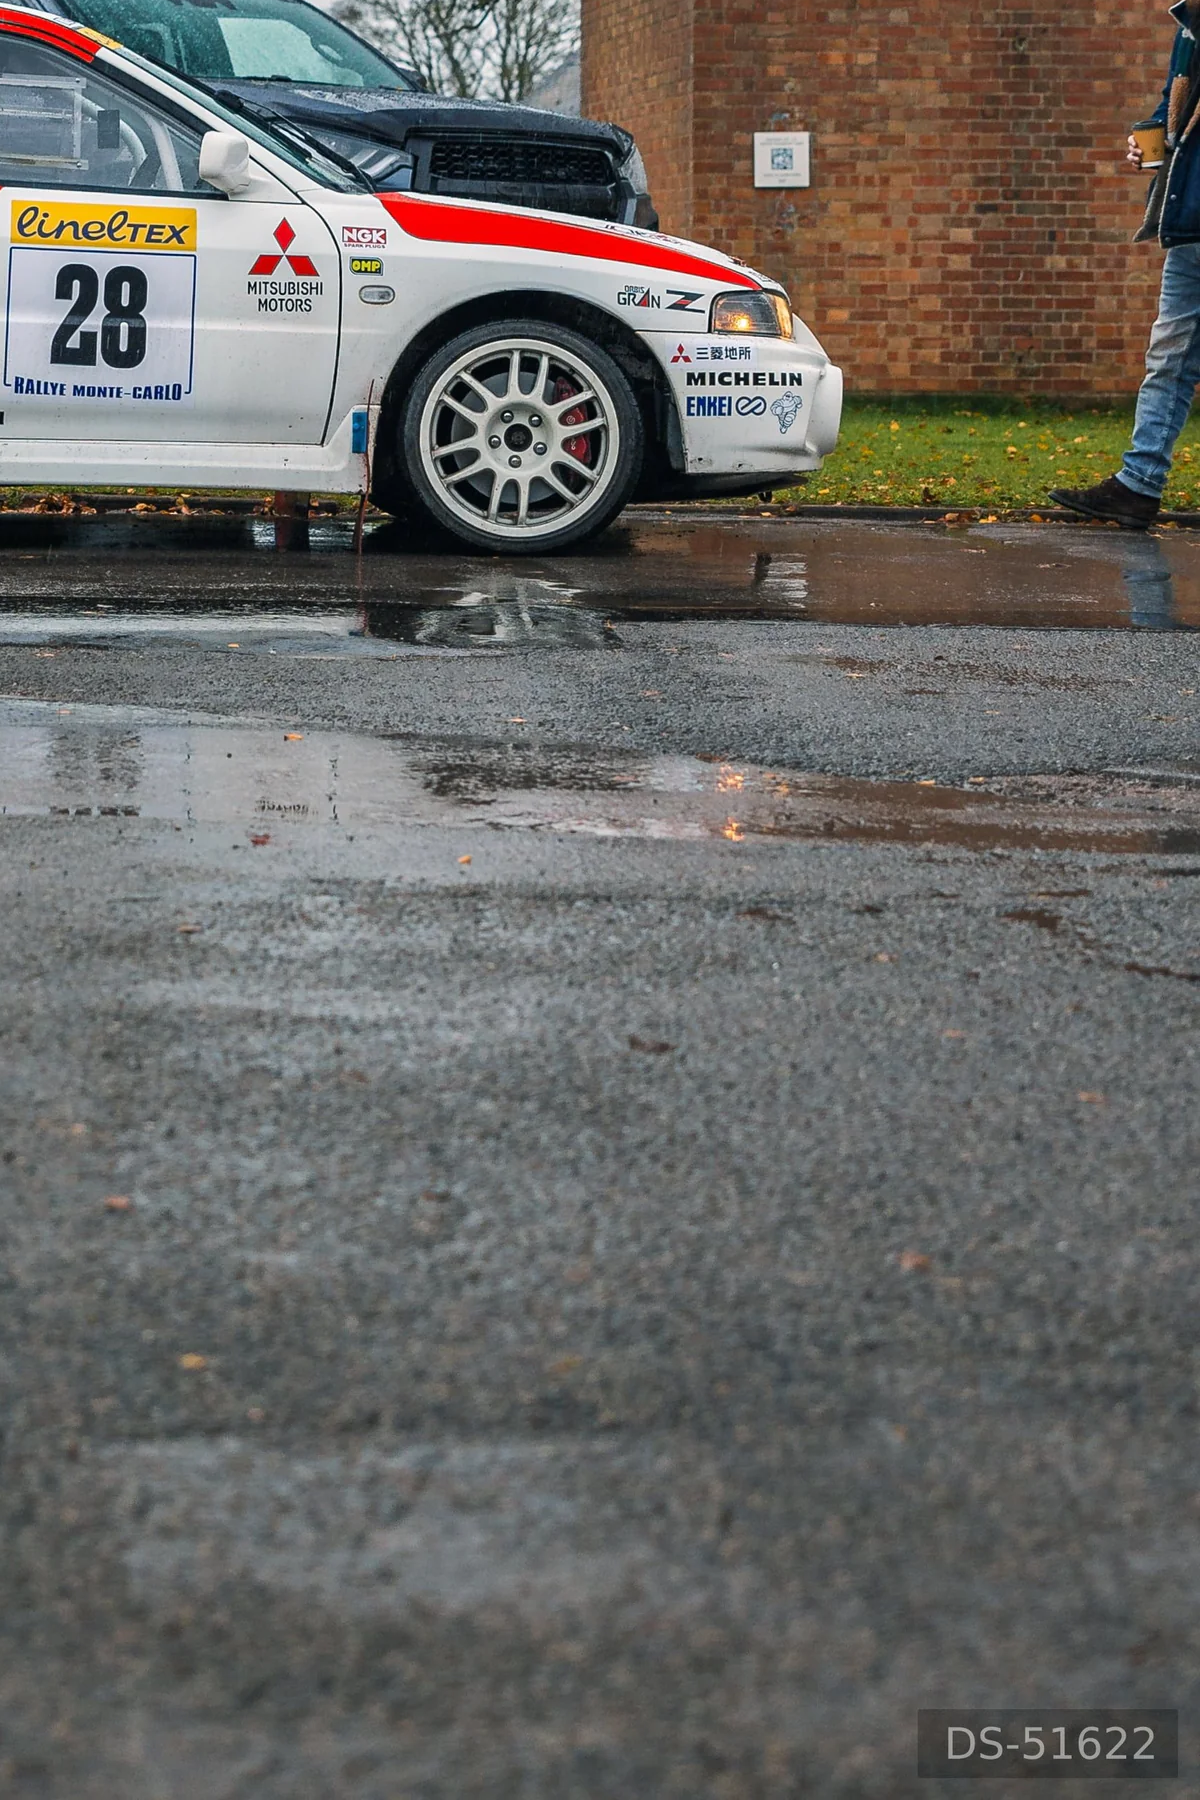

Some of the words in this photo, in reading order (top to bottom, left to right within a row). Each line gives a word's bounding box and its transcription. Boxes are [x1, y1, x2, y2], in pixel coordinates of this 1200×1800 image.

[343, 228, 386, 244] NGK
[352, 260, 380, 272] OMP
[247, 281, 323, 296] MITSUBISHI
[624, 285, 645, 294] ORBIS
[258, 298, 312, 312] MOTORS
[618, 287, 660, 309] GRAN
[50, 264, 147, 368] 28
[696, 346, 751, 360] 三菱地所
[686, 372, 803, 386] MICHELIN
[14, 376, 66, 396] RALLYE
[72, 383, 182, 400] MONTE-CARLO
[686, 396, 733, 417] ENKEI
